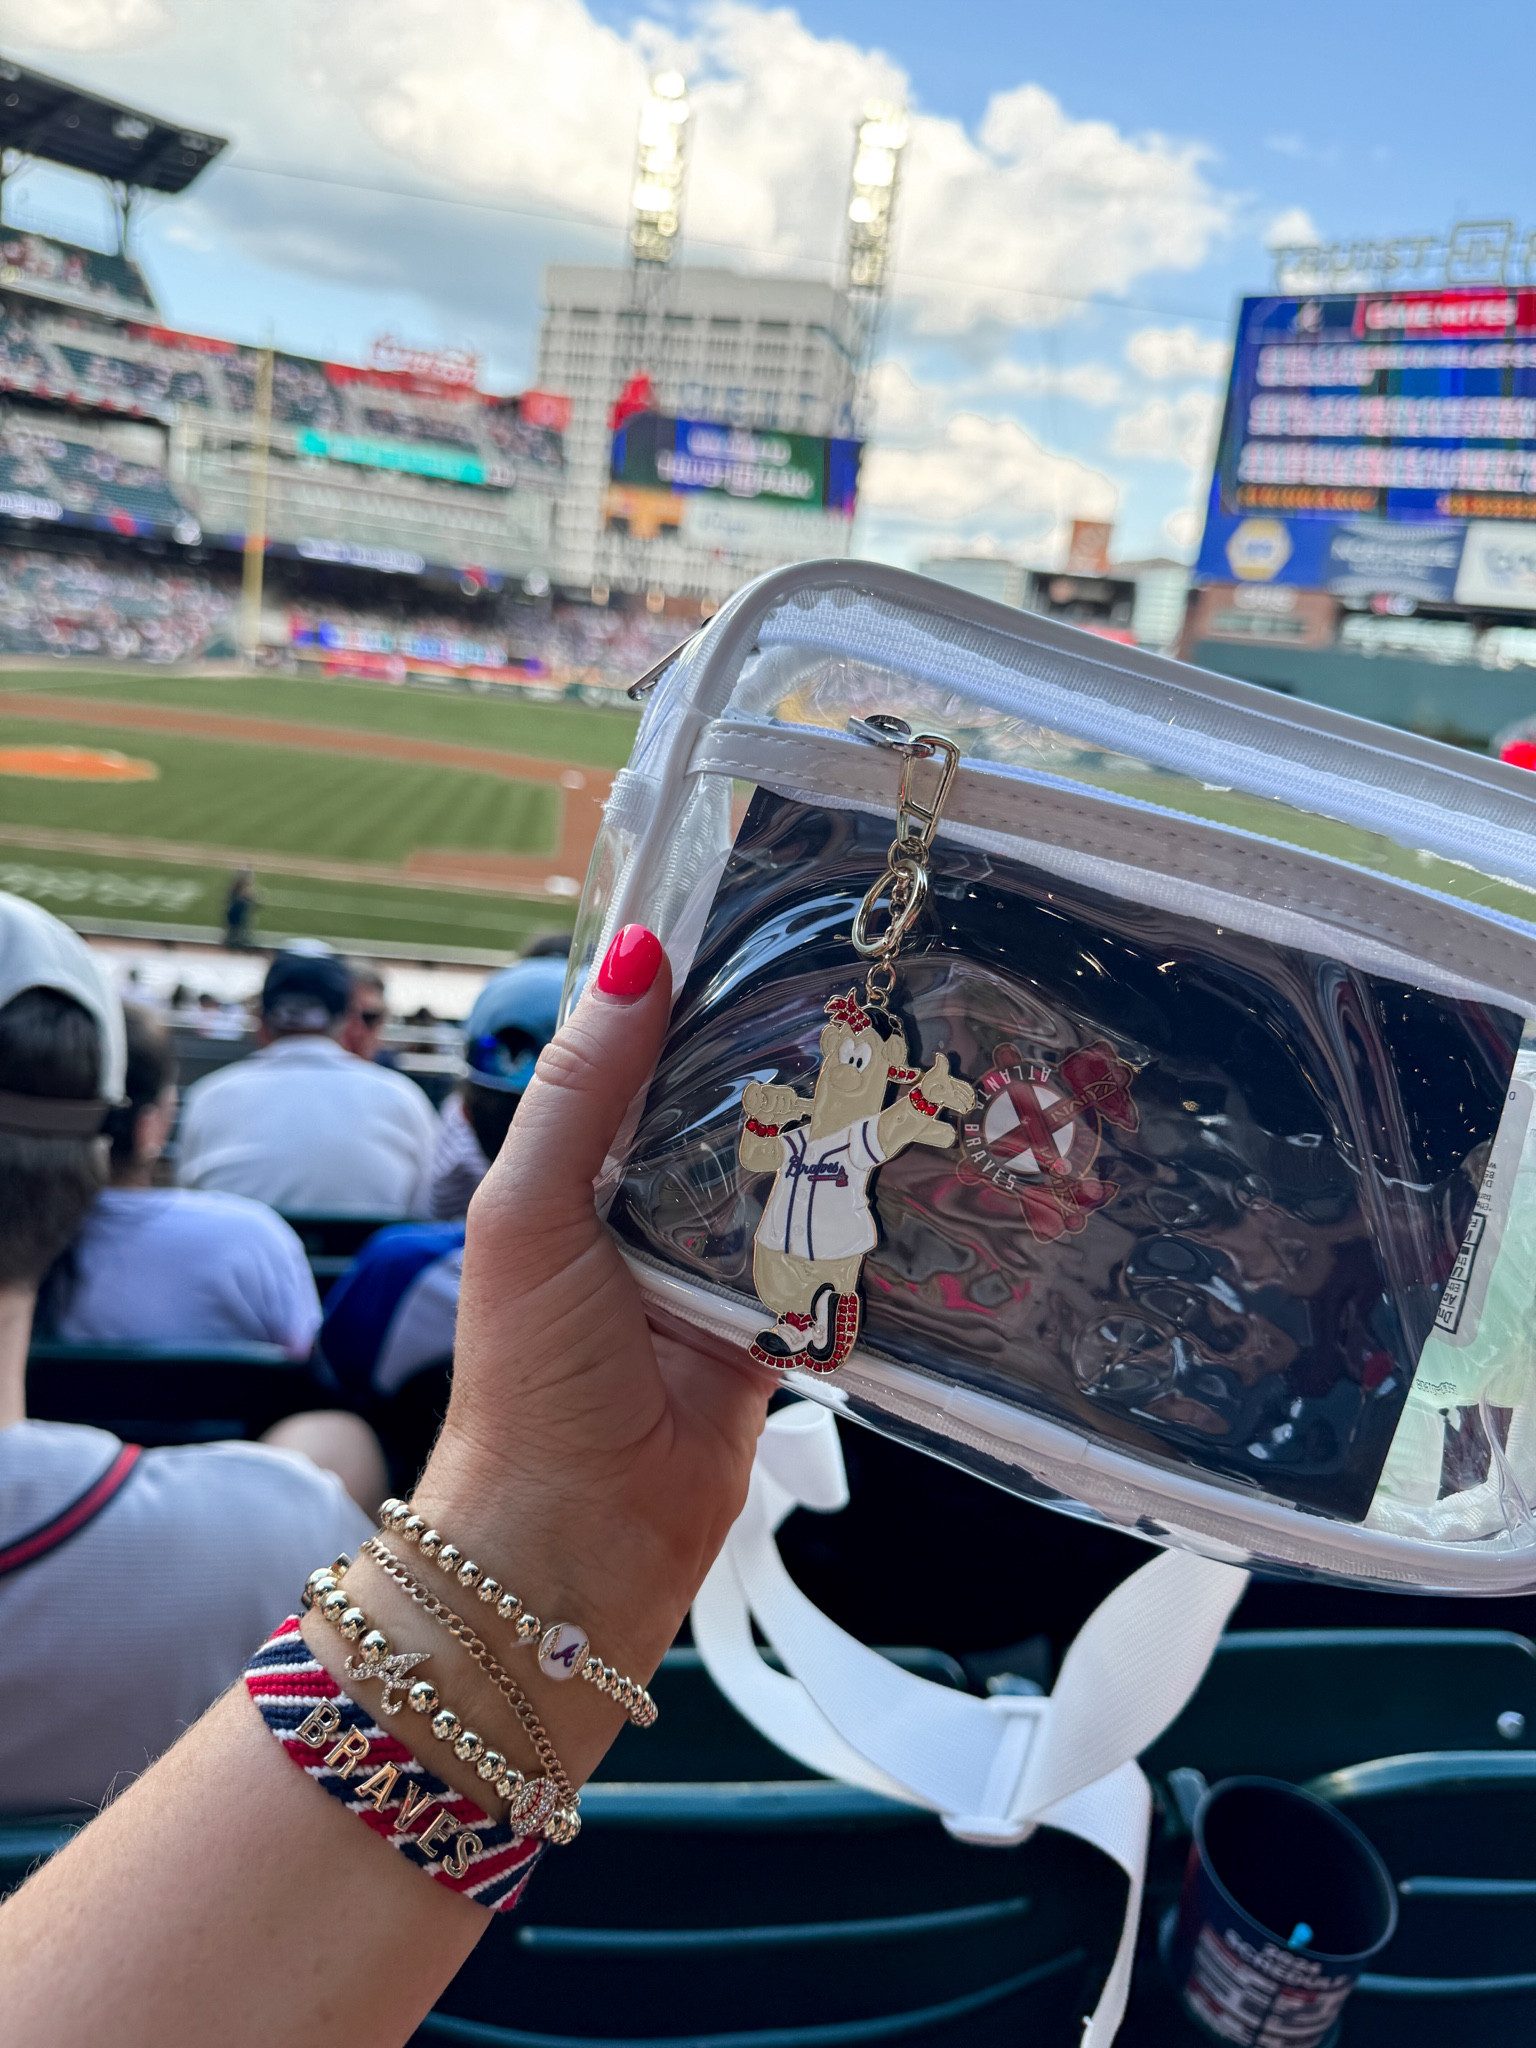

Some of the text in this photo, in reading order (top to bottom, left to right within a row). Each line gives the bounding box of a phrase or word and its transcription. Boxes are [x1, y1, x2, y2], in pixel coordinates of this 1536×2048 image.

[1269, 237, 1438, 275] TRUIST
[976, 1066, 1051, 1110] ATLANTA
[785, 1155, 840, 1178] Braves
[965, 1124, 1016, 1190] BRAVES
[295, 1697, 483, 1879] BRAVES
